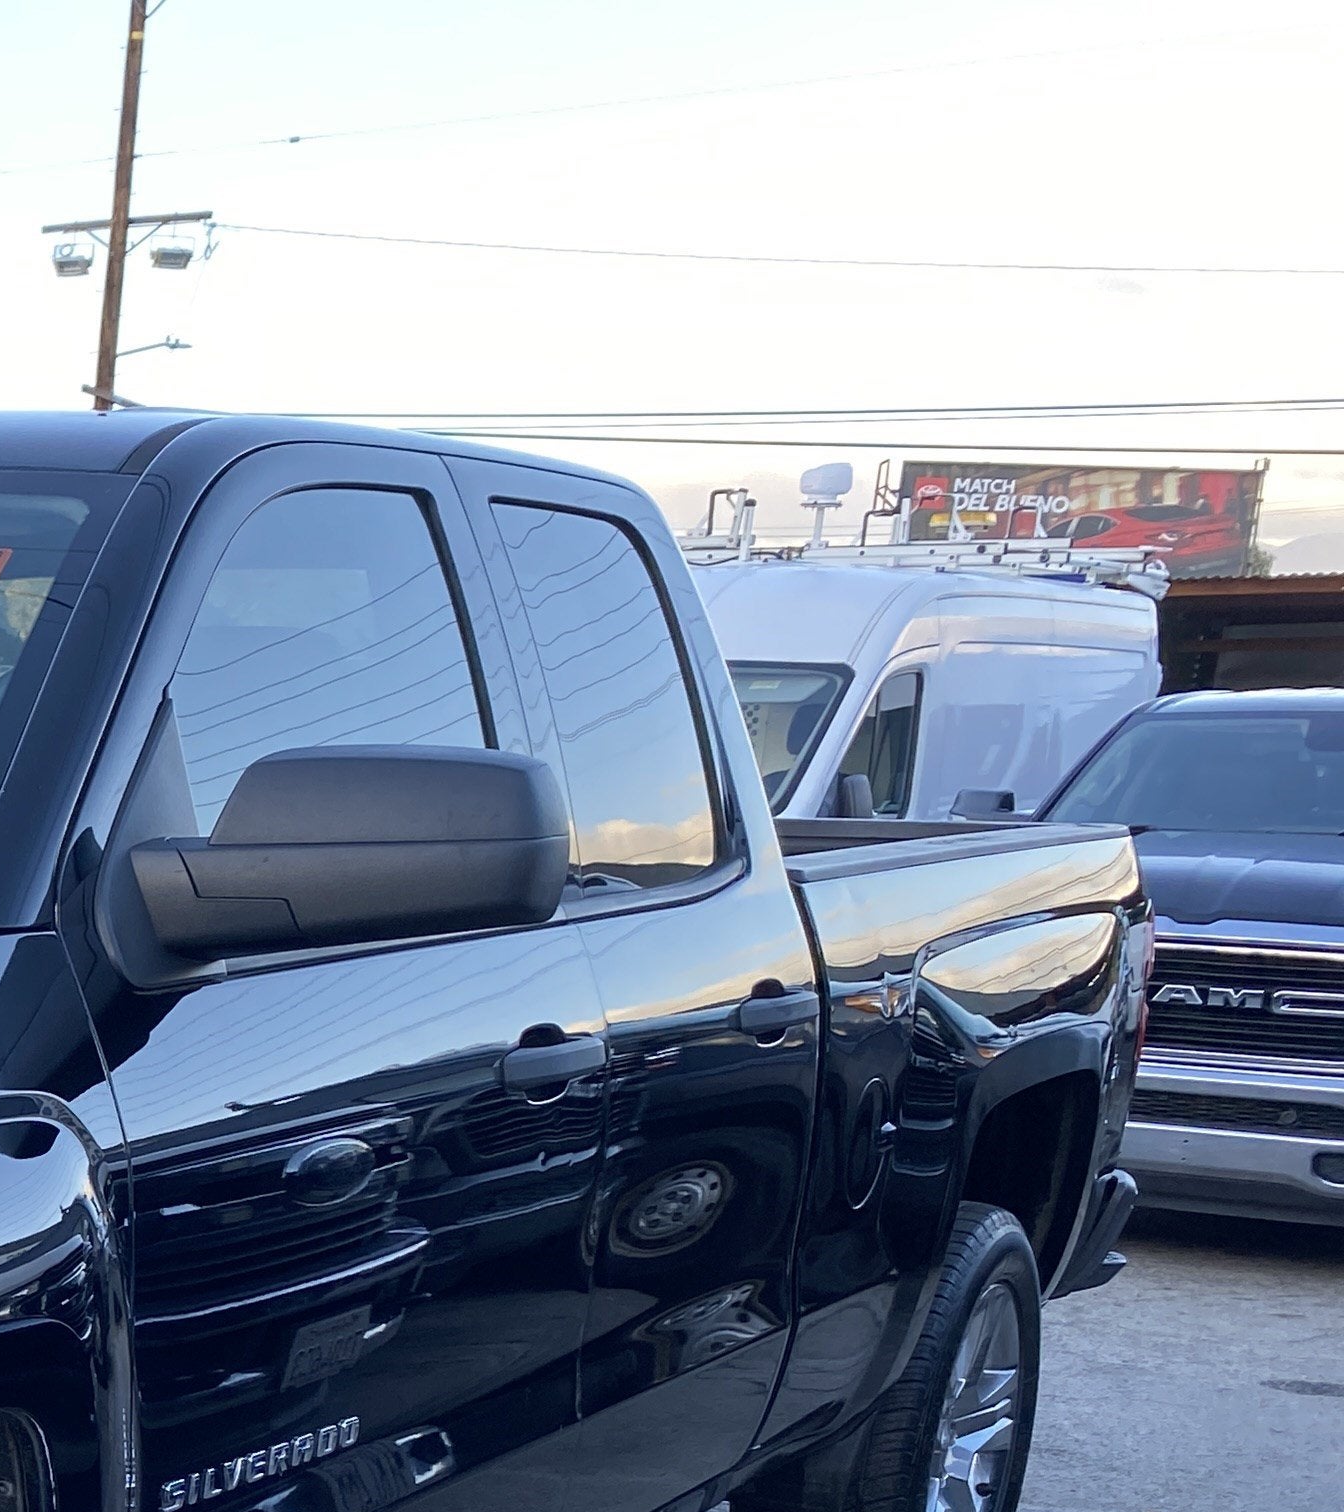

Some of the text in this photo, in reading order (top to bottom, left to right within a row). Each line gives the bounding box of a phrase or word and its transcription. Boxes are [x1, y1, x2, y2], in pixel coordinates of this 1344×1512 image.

[953, 477, 1016, 494] MATCH
[955, 493, 1069, 513] DEL BUENO
